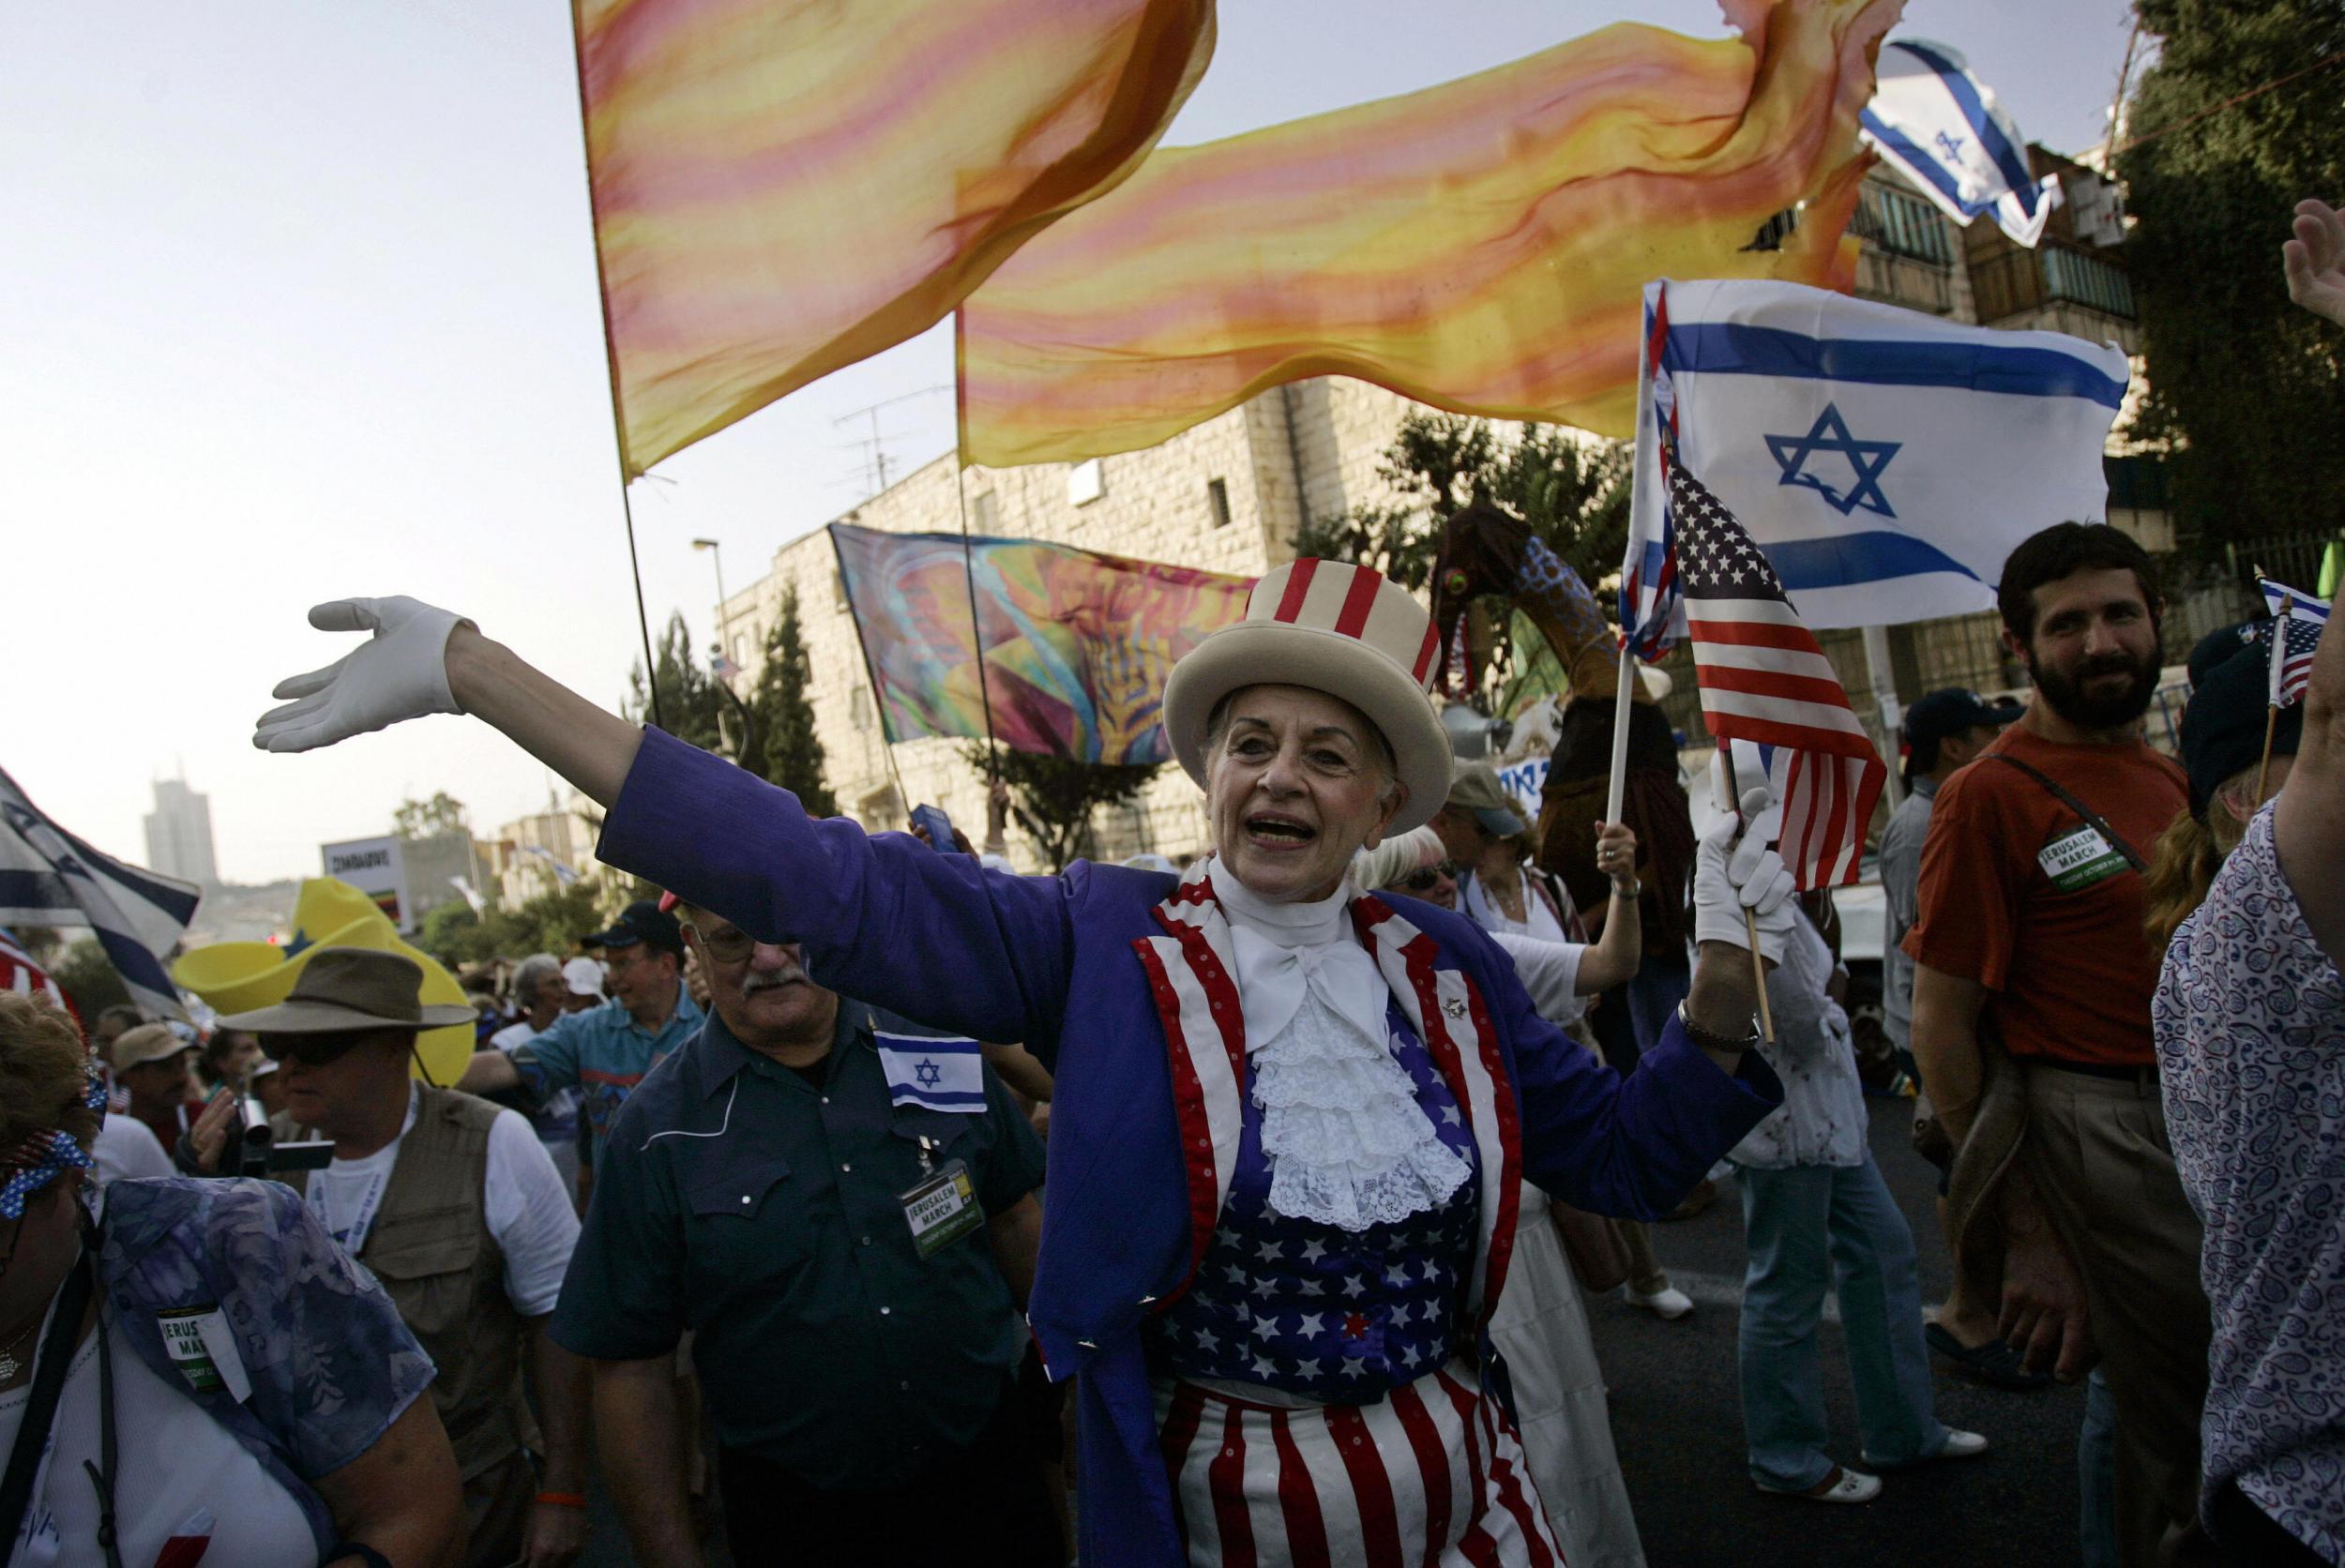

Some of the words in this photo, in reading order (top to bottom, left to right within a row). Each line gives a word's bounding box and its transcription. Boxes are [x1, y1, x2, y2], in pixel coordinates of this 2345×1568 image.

[2040, 831, 2098, 865] JERUSALEM
[2058, 845, 2097, 869] MARCH
[908, 1185, 956, 1221] JERUSALEM
[921, 1202, 953, 1227] MARCH
